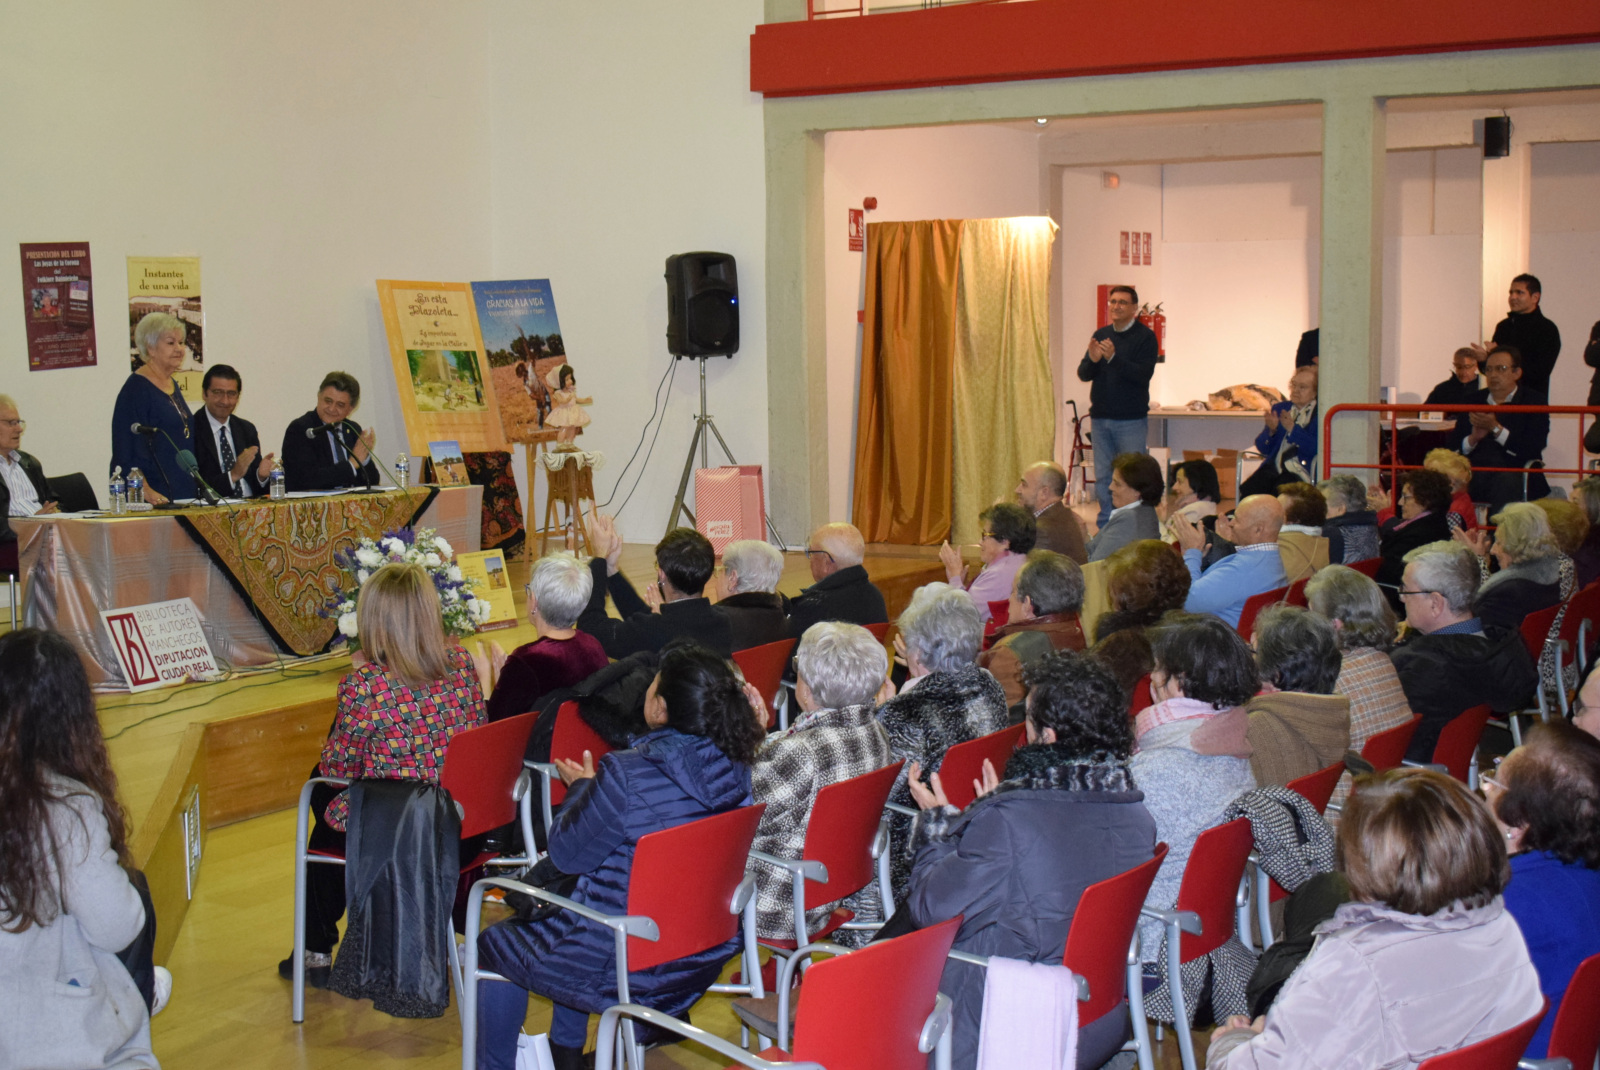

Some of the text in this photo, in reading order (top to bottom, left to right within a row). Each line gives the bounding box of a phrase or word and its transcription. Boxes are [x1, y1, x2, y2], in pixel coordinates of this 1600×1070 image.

[144, 268, 184, 278] Instantes
[139, 280, 150, 290] de
[172, 280, 189, 290] vida
[431, 294, 448, 304] esta
[486, 297, 544, 308] GRACIAS A LA VIDA
[137, 603, 192, 622] BIBLIOTECA
[142, 617, 196, 637] DE AUTORES
[148, 632, 202, 651] MANCHEGOS
[154, 646, 208, 666] DIPUTACION
[161, 660, 214, 680] CIUDAD REAL
